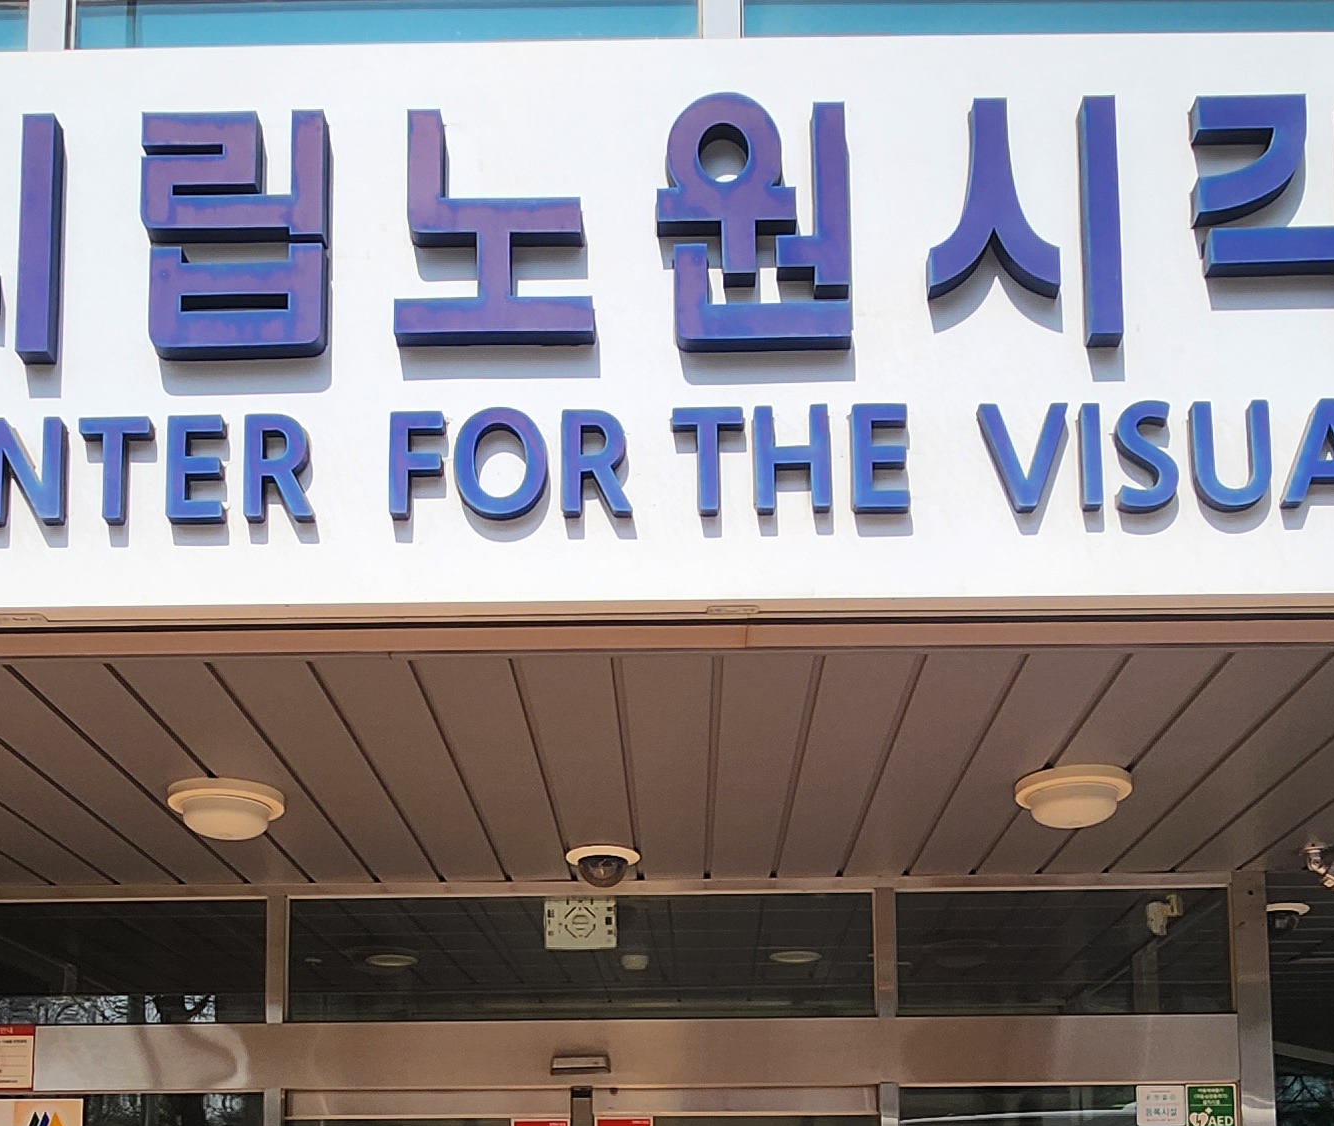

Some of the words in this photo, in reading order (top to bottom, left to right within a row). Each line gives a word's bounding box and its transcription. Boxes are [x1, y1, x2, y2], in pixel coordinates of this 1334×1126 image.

[387, 409, 633, 520] FOR
[670, 403, 910, 516] THE
[1207, 1116, 1233, 1126] AED
